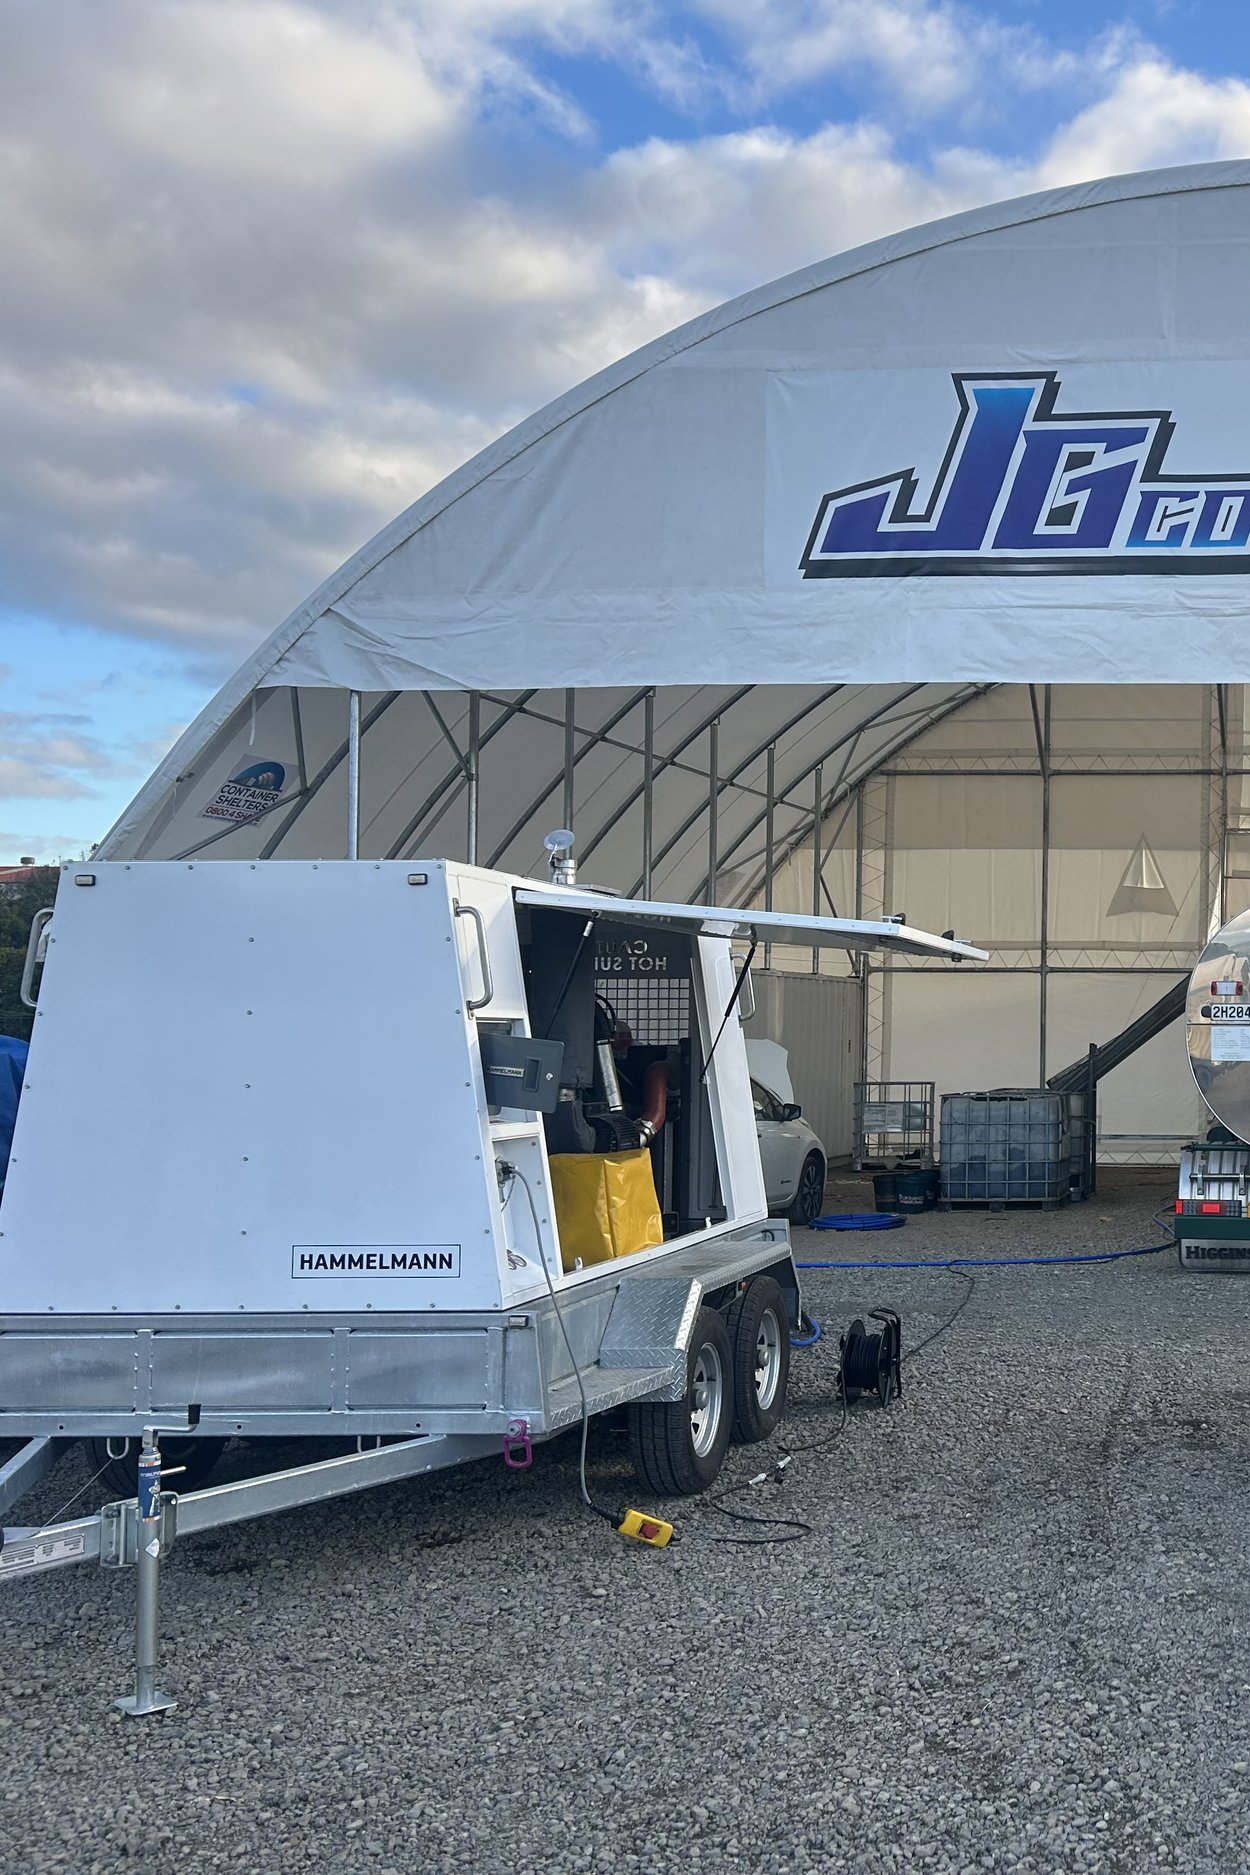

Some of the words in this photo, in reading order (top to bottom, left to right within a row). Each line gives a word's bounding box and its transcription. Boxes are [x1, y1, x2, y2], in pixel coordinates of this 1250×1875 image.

[806, 378, 1164, 564] JG
[221, 784, 279, 803] CONTAINER
[205, 806, 230, 817] 0800
[215, 795, 269, 812] SHELTERS
[1212, 1006, 1250, 1018] 2H204
[300, 1253, 453, 1270] HAMMELMANN
